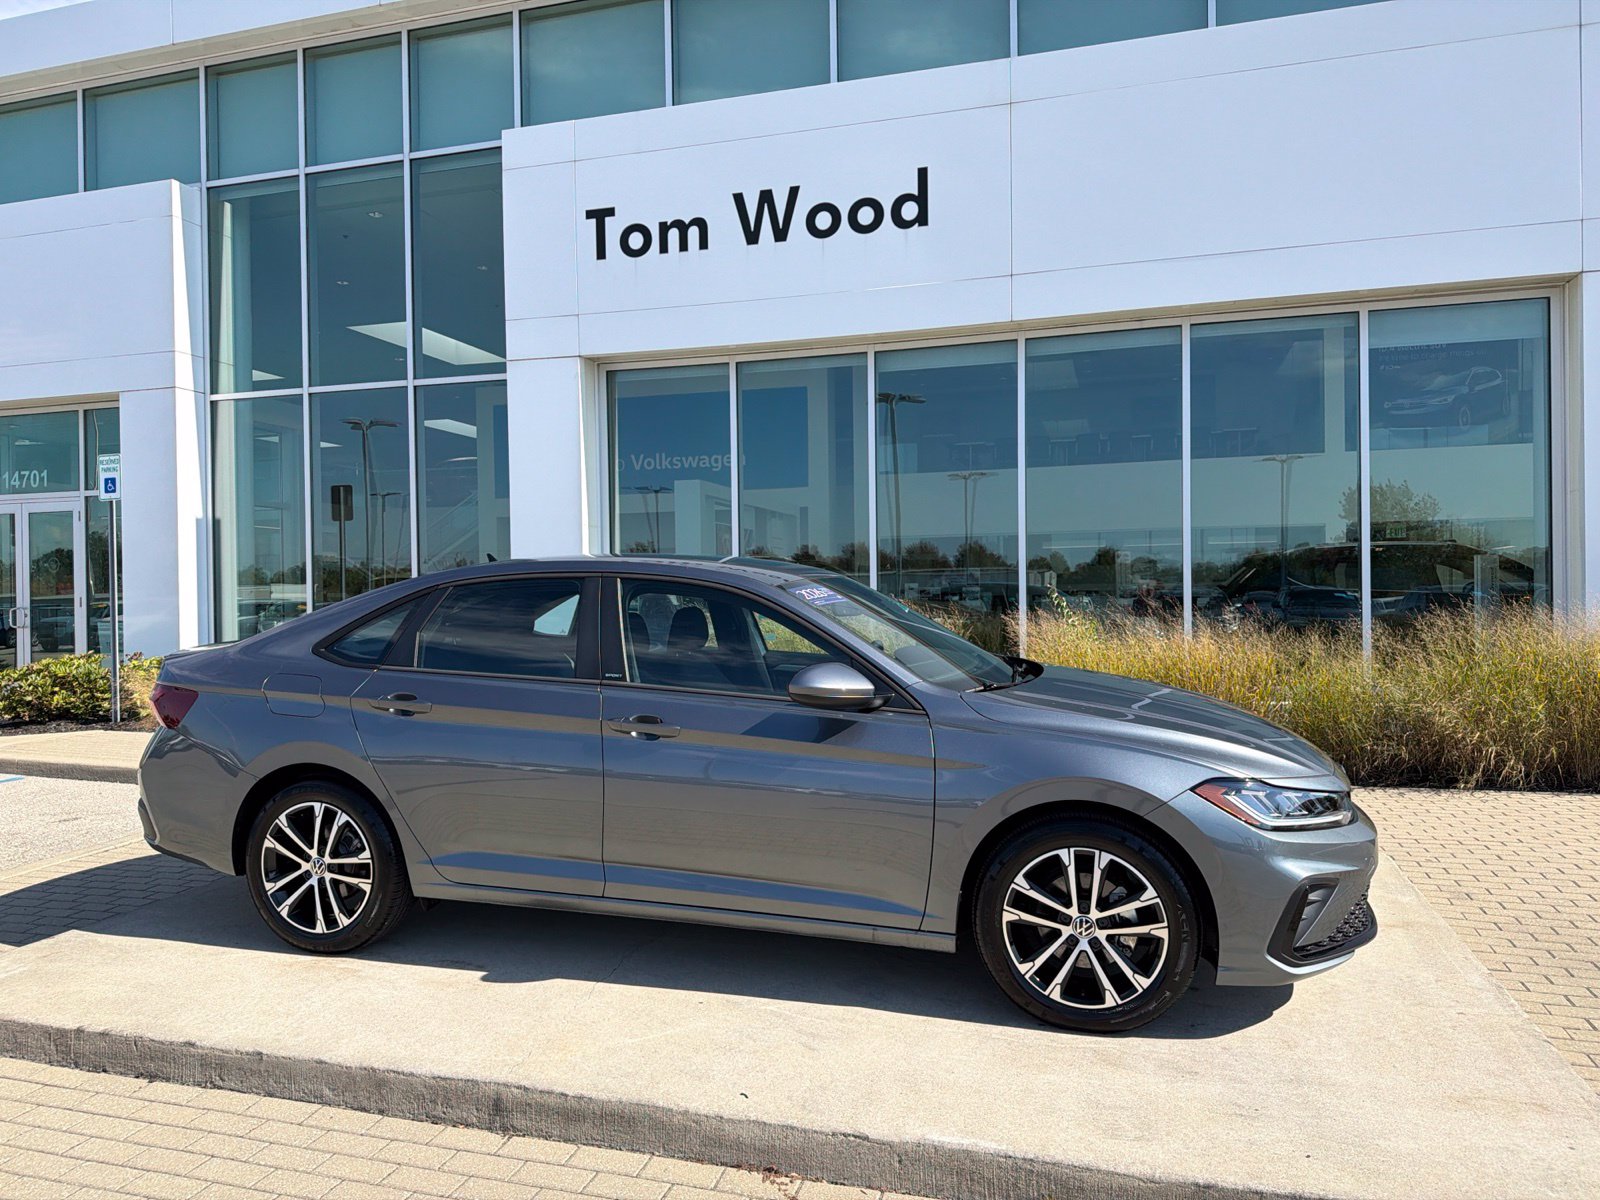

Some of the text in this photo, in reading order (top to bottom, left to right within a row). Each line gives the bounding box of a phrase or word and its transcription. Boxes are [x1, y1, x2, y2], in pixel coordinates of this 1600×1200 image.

[585, 166, 929, 260] Tom Wood
[2, 469, 48, 489] 14701
